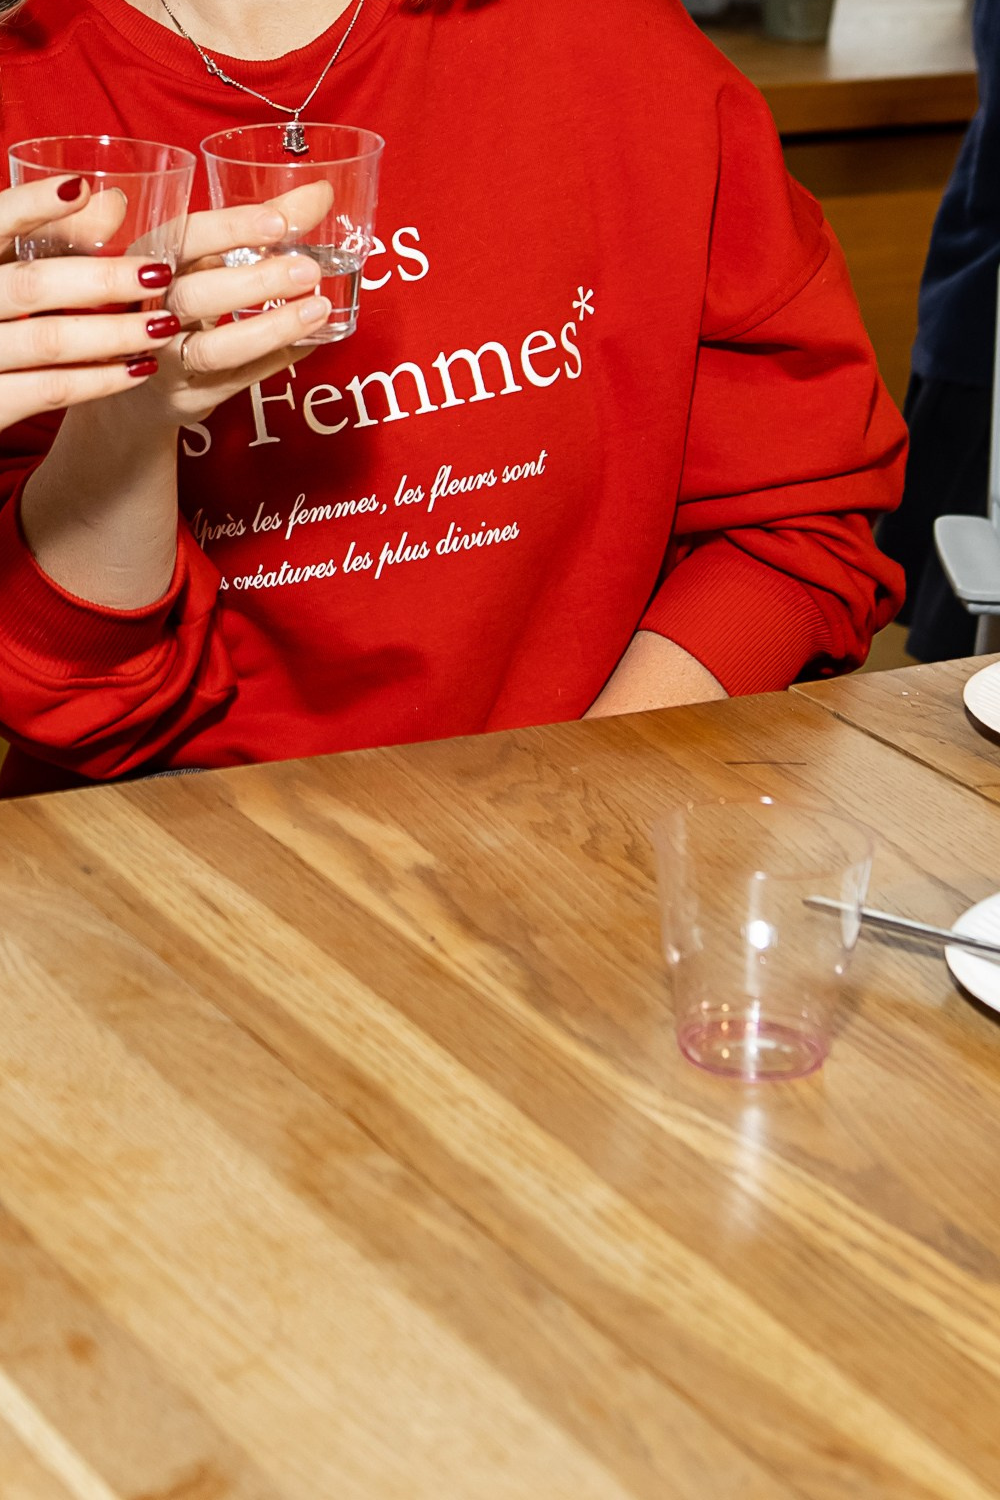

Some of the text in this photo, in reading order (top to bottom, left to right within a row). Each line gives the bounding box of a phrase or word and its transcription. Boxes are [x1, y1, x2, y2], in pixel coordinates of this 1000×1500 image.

[252, 501, 283, 533] les
[284, 492, 388, 541] femmes,
[393, 474, 426, 507] les
[427, 464, 498, 513] fleurs
[501, 449, 549, 484] sont
[233, 560, 338, 590] créatures
[342, 541, 374, 574] les
[374, 531, 431, 580] plus
[435, 521, 520, 556] divines
